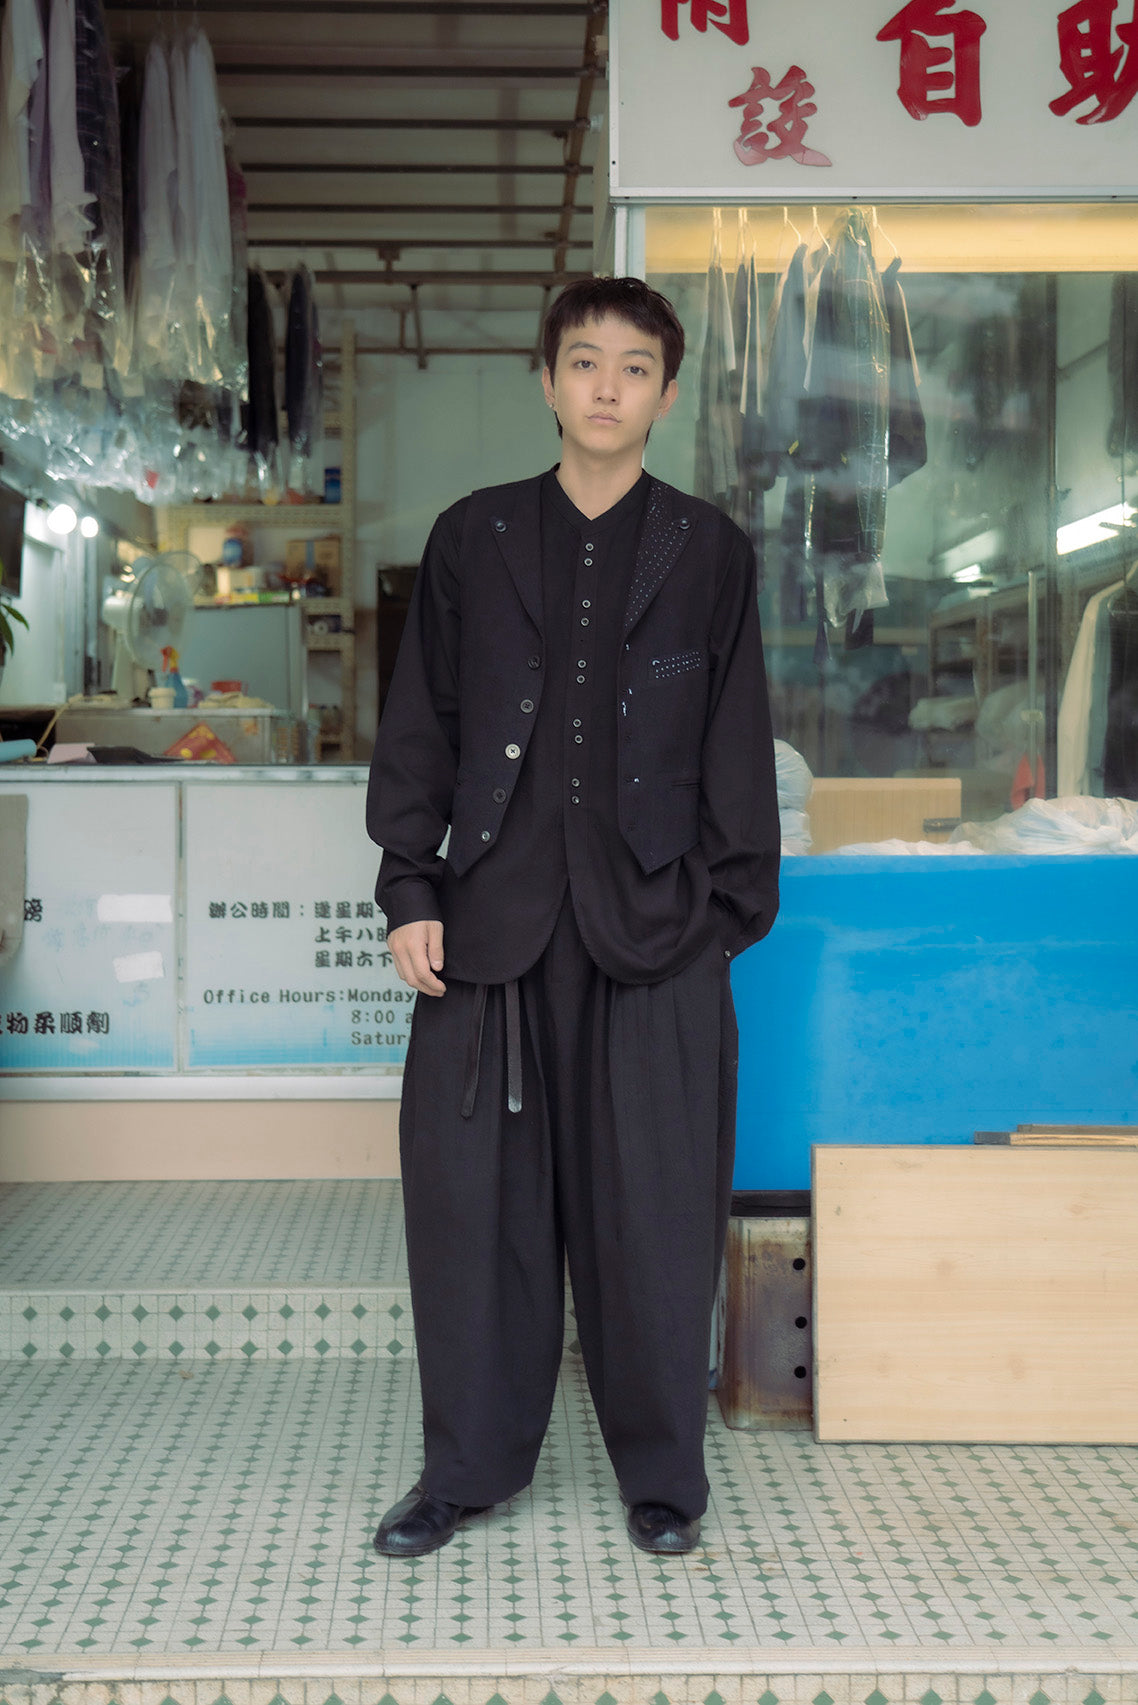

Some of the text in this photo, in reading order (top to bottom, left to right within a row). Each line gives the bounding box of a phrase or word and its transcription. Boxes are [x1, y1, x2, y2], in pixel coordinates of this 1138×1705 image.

[203, 989, 270, 1004] Office
[0, 1011, 110, 1034] 物柔順劑
[351, 1009, 395, 1024] 8:00
